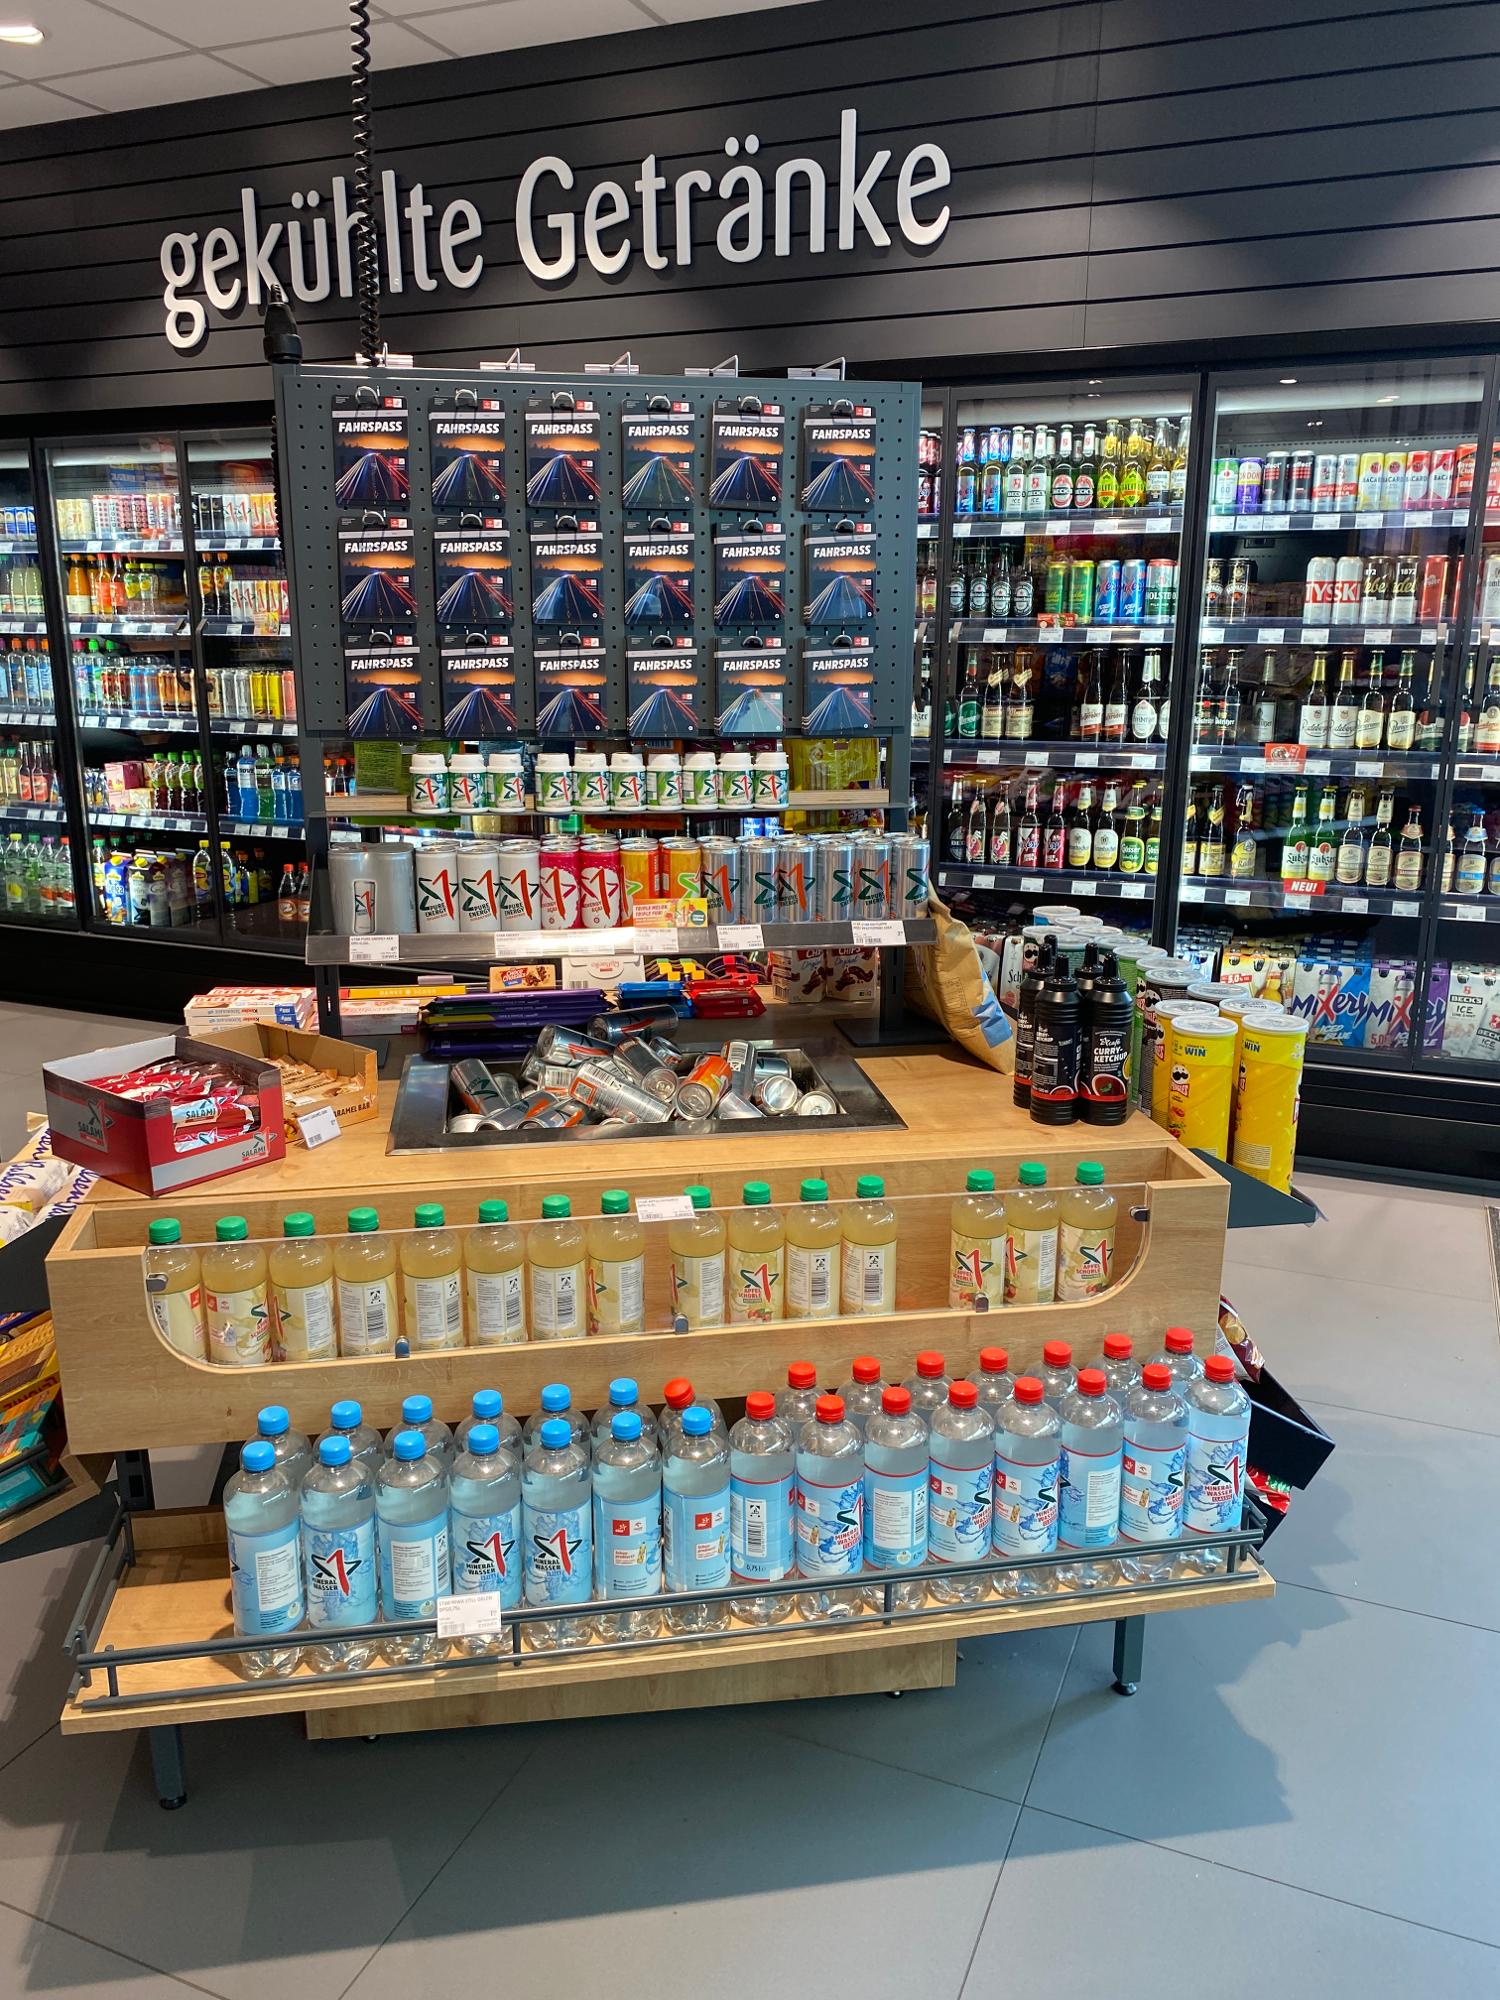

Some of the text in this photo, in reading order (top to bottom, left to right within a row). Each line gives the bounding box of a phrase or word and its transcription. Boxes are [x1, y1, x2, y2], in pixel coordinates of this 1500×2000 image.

[160, 108, 953, 349] gekühlte Getränke
[338, 421, 402, 433] FAHRSPASS
[436, 422, 499, 434] FAHRSPASS
[531, 423, 593, 435] FAHRSPASS
[628, 425, 689, 437] FAHRSPASS
[718, 425, 779, 438] FAHRSPASS
[812, 428, 871, 440] FAHRSPASS
[344, 540, 408, 553] FAHRSPASS
[440, 541, 502, 553] FAHRSPASS
[536, 543, 596, 556] FAHRSPASS
[629, 544, 688, 556] FAHRSPASS
[722, 545, 781, 558] FAHRSPASS
[814, 545, 871, 558] FAHRSPASS
[351, 657, 413, 670] FAHRSPASS
[447, 658, 508, 670] FAHRSPASS
[540, 659, 599, 672] FAHRSPASS
[633, 659, 692, 671] FAHRSPASS
[723, 659, 781, 672] FAHRSPASS
[812, 658, 869, 671] FAHRSPASS
[1290, 879, 1318, 893] NEU!
[1456, 1005, 1473, 1014] ICE
[1093, 1046, 1123, 1056] CURRY-
[1184, 1046, 1206, 1057] WIN
[1244, 1041, 1261, 1053] WIN
[1094, 1051, 1128, 1063] KETCHUP
[185, 1108, 216, 1119] SALAMI
[334, 1105, 357, 1117] ARAMEL
[241, 1147, 266, 1158] SALAMI
[1206, 1489, 1233, 1497] WASSER
[466, 1563, 495, 1571] MINERAL
[533, 1558, 560, 1566] MINERAL
[535, 1563, 561, 1572] WASSER
[467, 1568, 496, 1576] WASSER
[312, 1579, 337, 1587] MINERAL
[313, 1584, 338, 1592] WASSER
